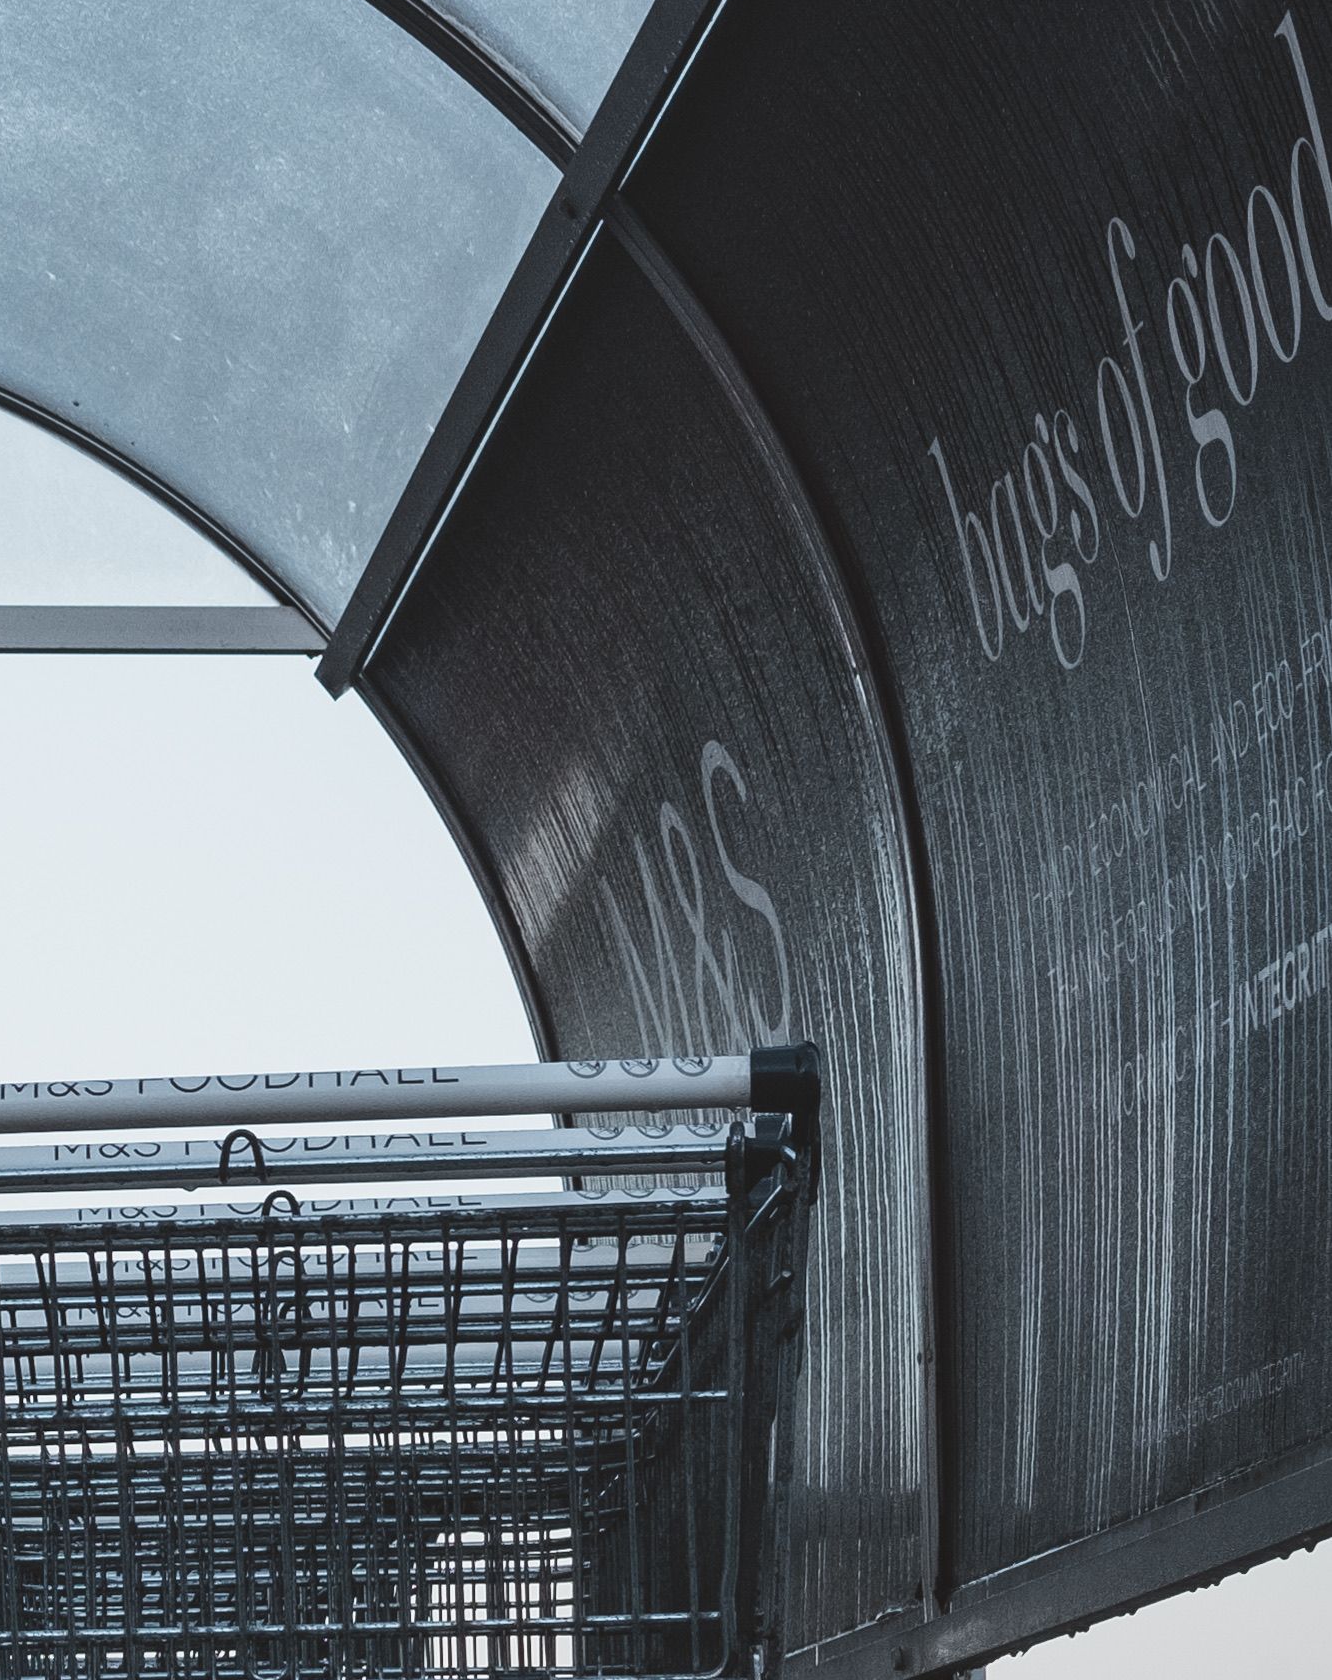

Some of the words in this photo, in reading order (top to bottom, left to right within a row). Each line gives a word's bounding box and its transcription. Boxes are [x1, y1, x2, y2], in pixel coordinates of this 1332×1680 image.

[929, 408, 1098, 672] bags
[1098, 216, 1172, 582] of
[1168, 10, 1332, 527] good
[1253, 615, 1332, 744] ECO-FRI
[601, 738, 792, 1058] M&S
[1238, 922, 1332, 1040] INTEGRIT
